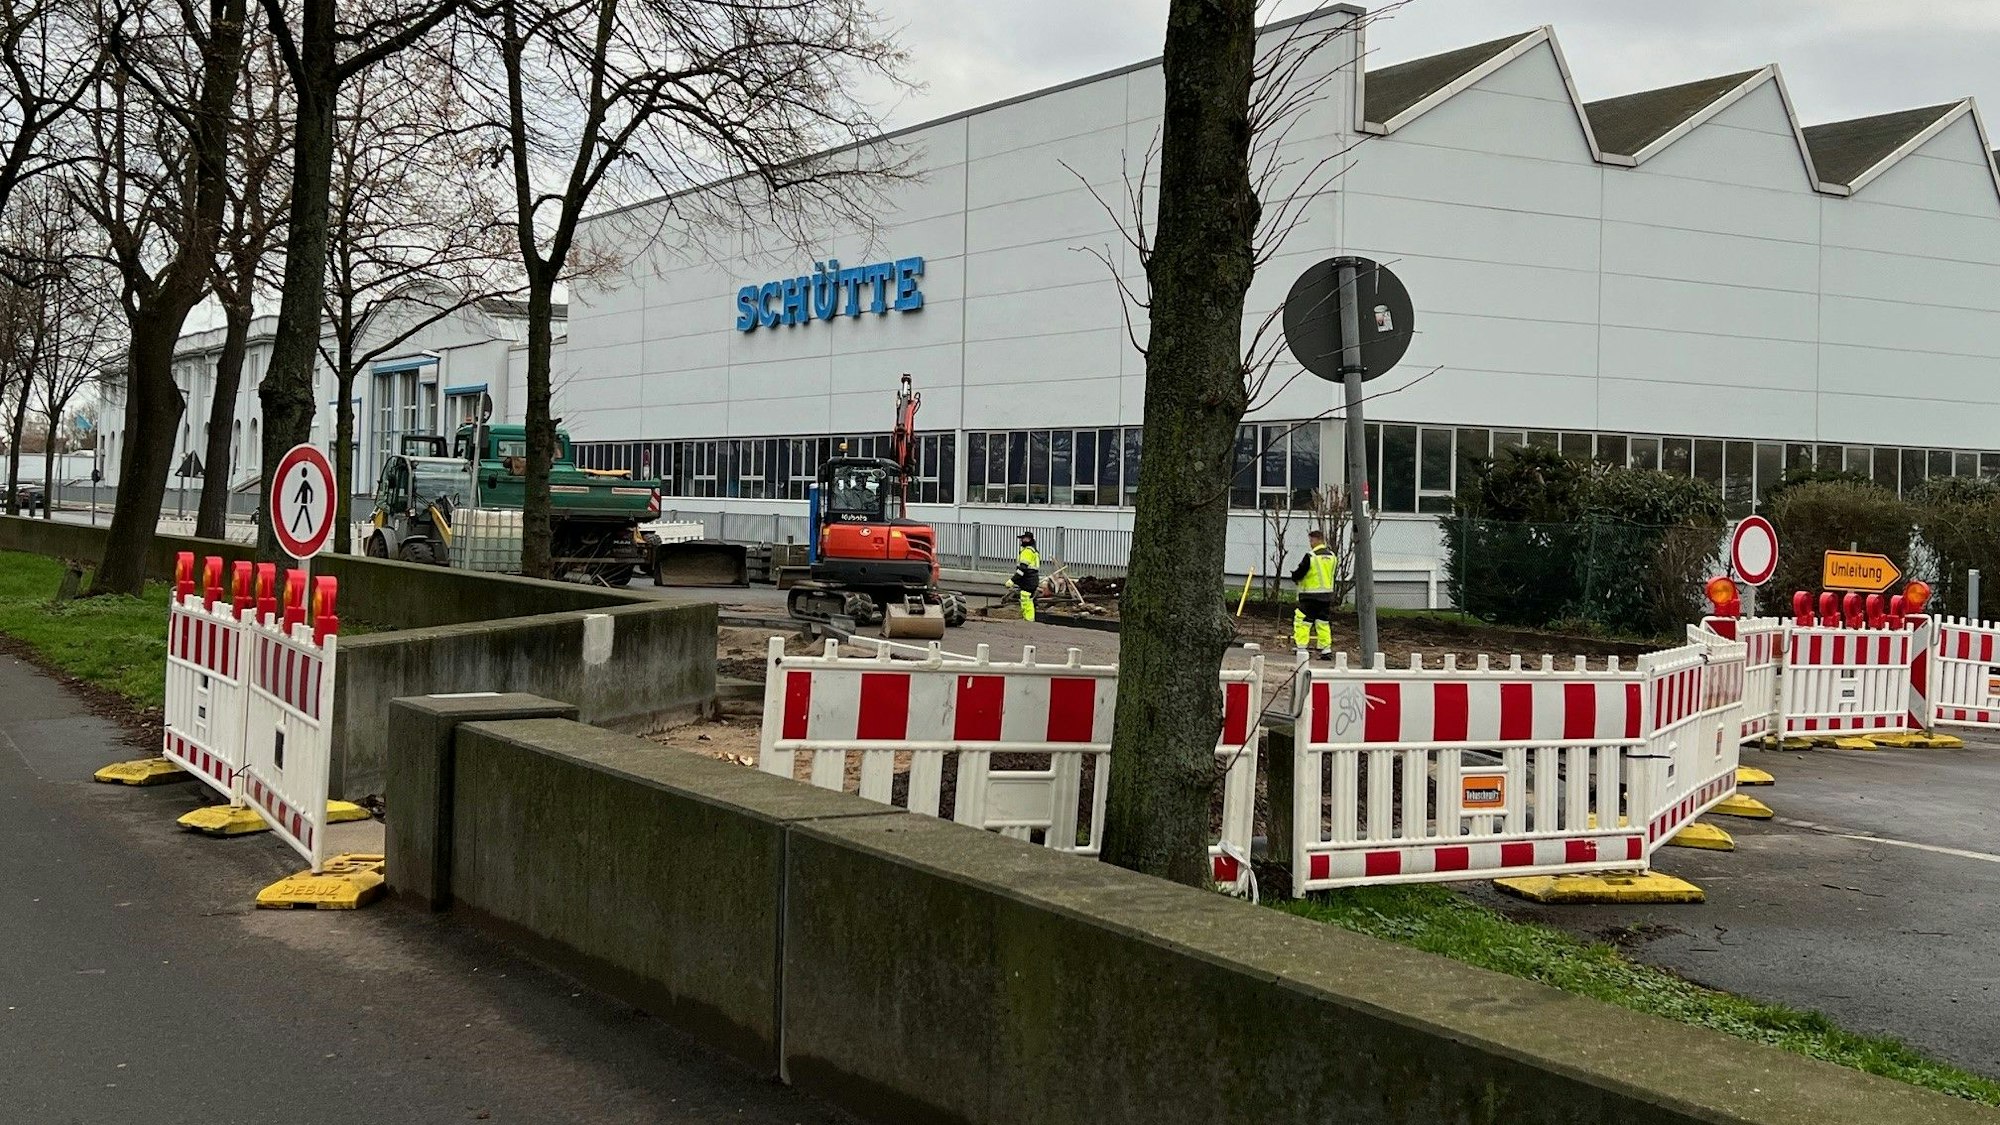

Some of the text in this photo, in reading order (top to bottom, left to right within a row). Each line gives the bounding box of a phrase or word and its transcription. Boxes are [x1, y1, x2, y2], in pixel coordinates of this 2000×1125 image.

[737, 256, 924, 332] SCHÜTTE
[841, 513, 868, 522] Kubota
[1831, 561, 1882, 582] Umleitung
[281, 884, 342, 896] DEBUZ
